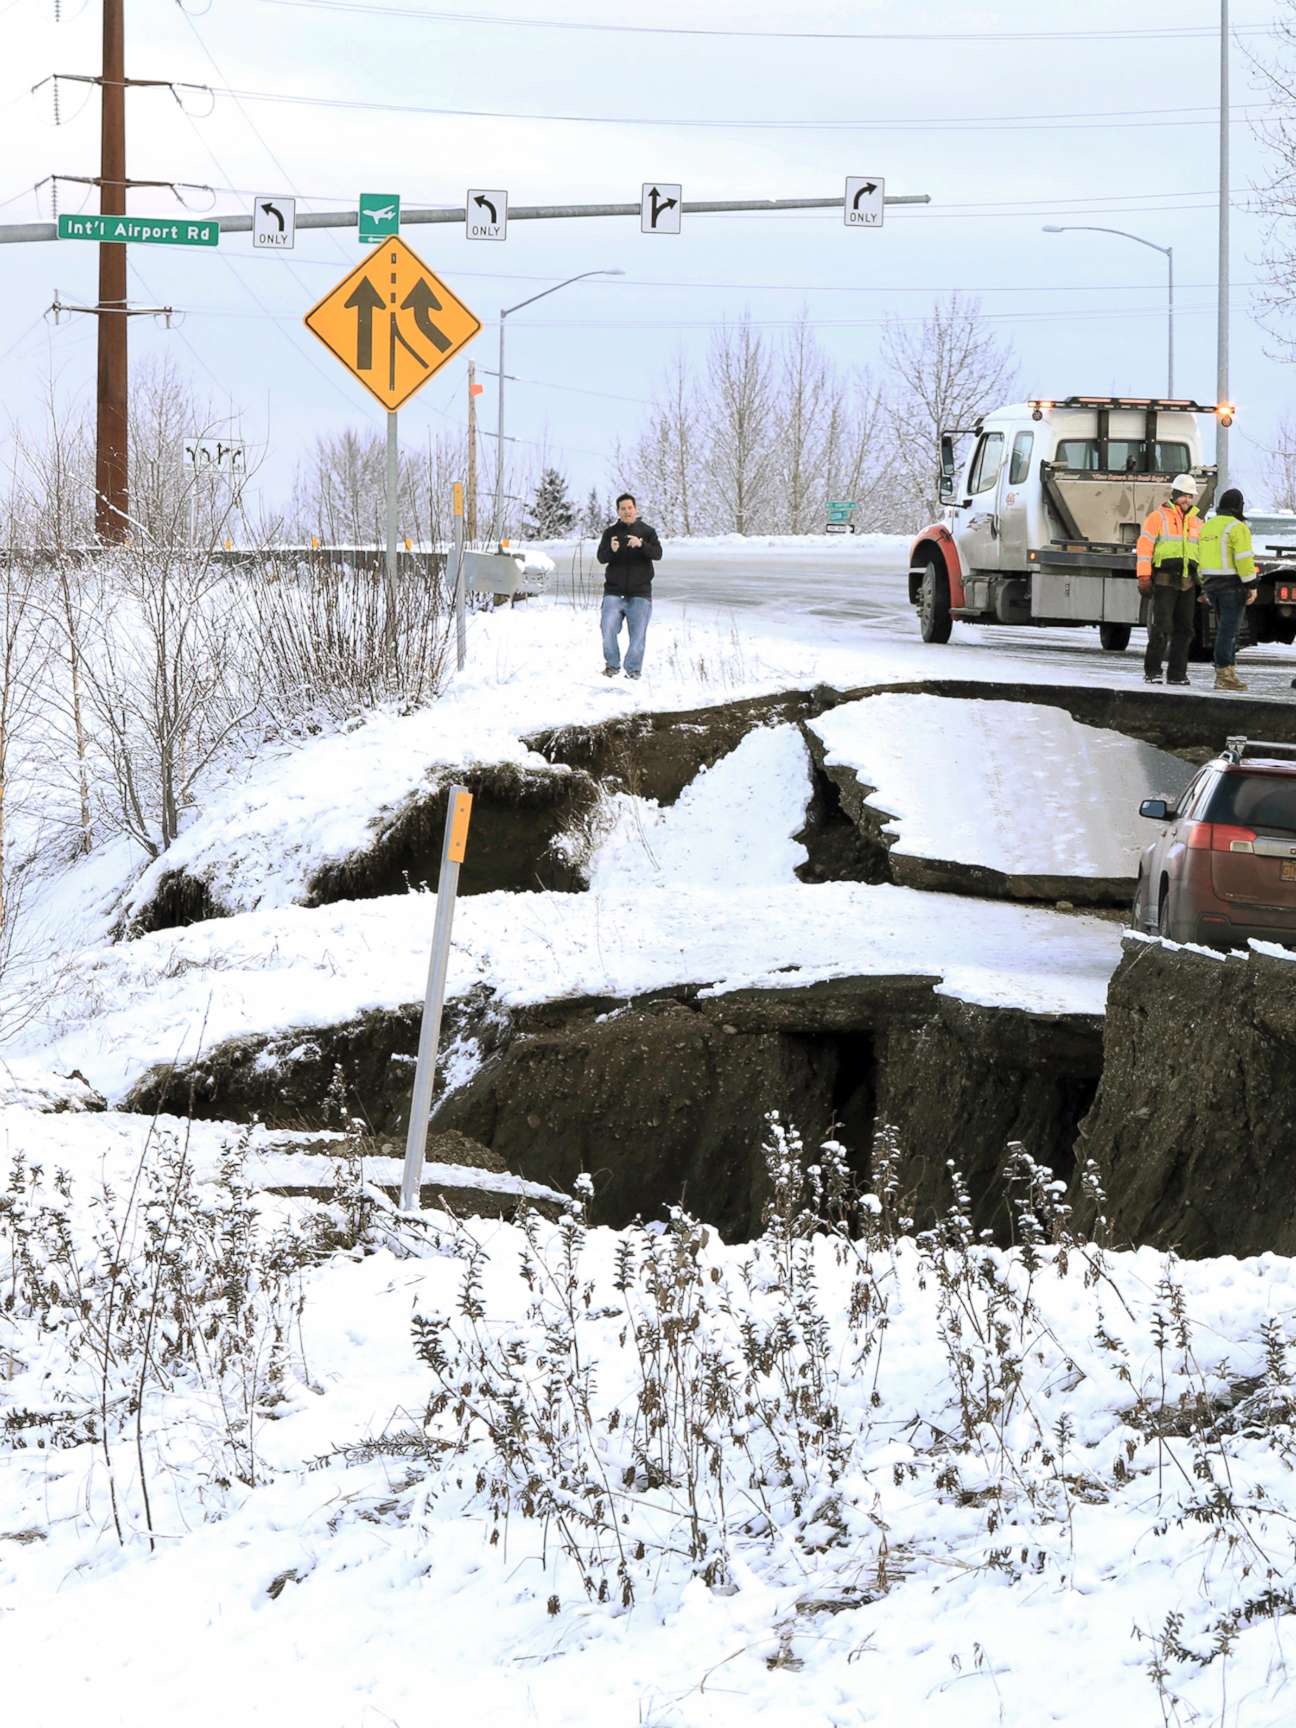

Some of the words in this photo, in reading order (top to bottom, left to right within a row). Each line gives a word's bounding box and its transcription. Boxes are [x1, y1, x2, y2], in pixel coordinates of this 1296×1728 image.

[850, 212, 878, 223] ONLY
[67, 220, 105, 236] Int'l
[114, 223, 178, 240] Airport
[187, 226, 210, 241] Rd
[471, 225, 501, 237] ONLY
[259, 233, 288, 245] ONLY
